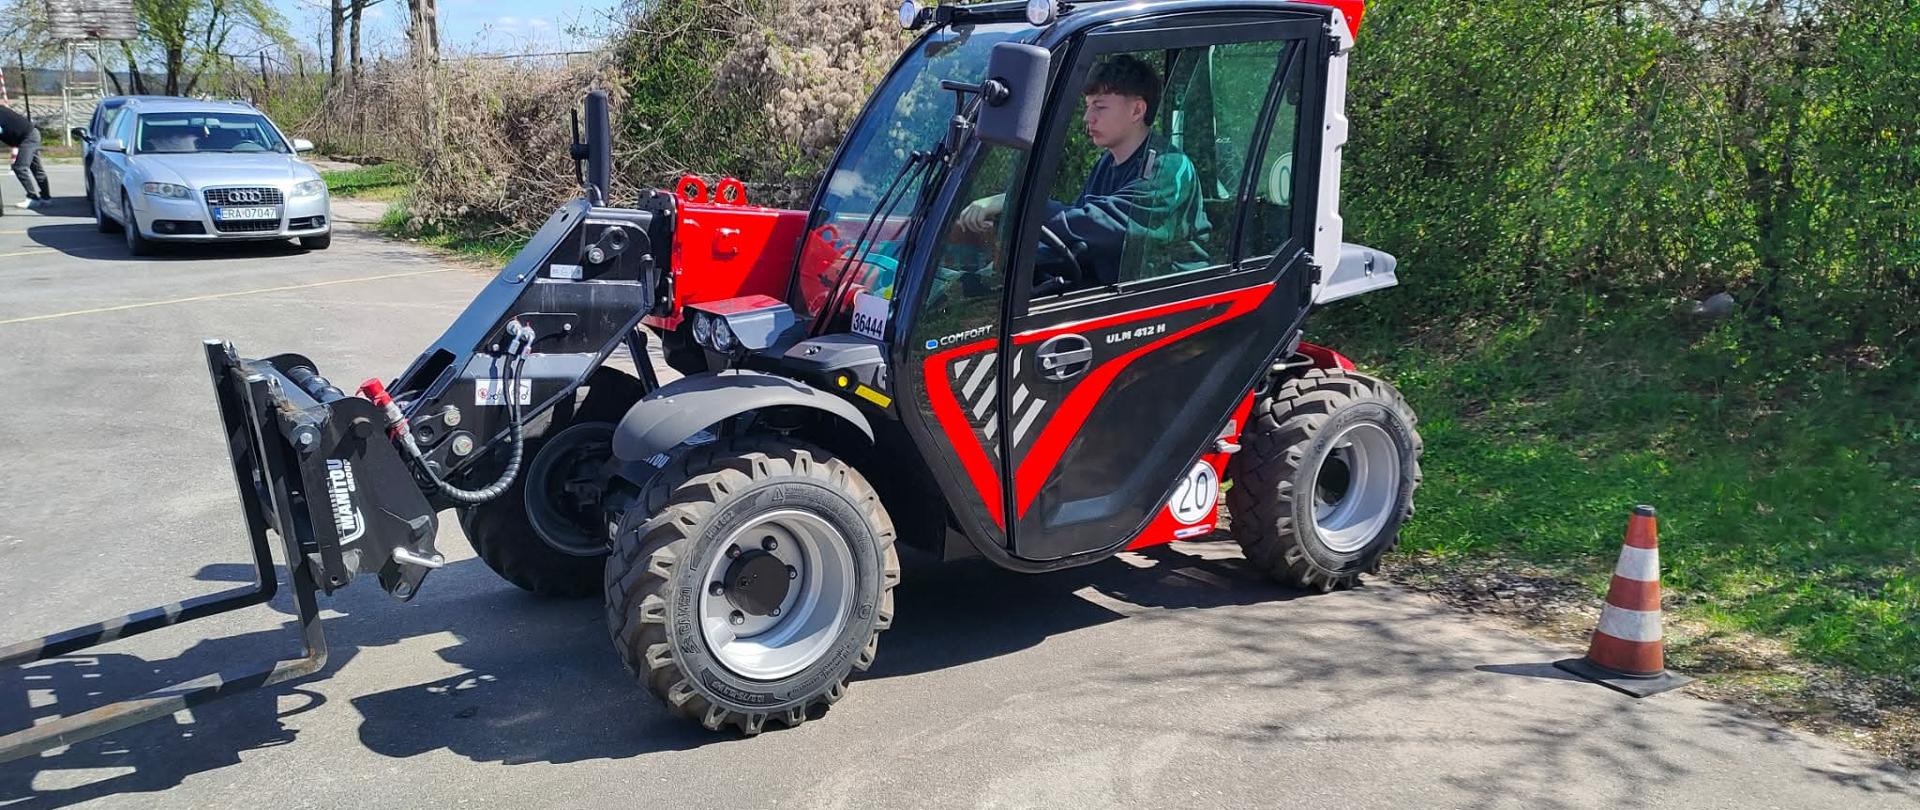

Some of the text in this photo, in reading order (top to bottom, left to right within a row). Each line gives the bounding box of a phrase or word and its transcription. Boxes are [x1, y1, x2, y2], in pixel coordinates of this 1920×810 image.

[222, 208, 242, 219] ERA
[244, 208, 276, 218] 07047
[853, 312, 884, 338] 36444
[940, 324, 994, 346] COMFORT
[1106, 323, 1166, 344] ULM 412 H
[343, 459, 356, 492] GROUP
[326, 459, 356, 530] MANITOU
[1179, 471, 1208, 514] 20
